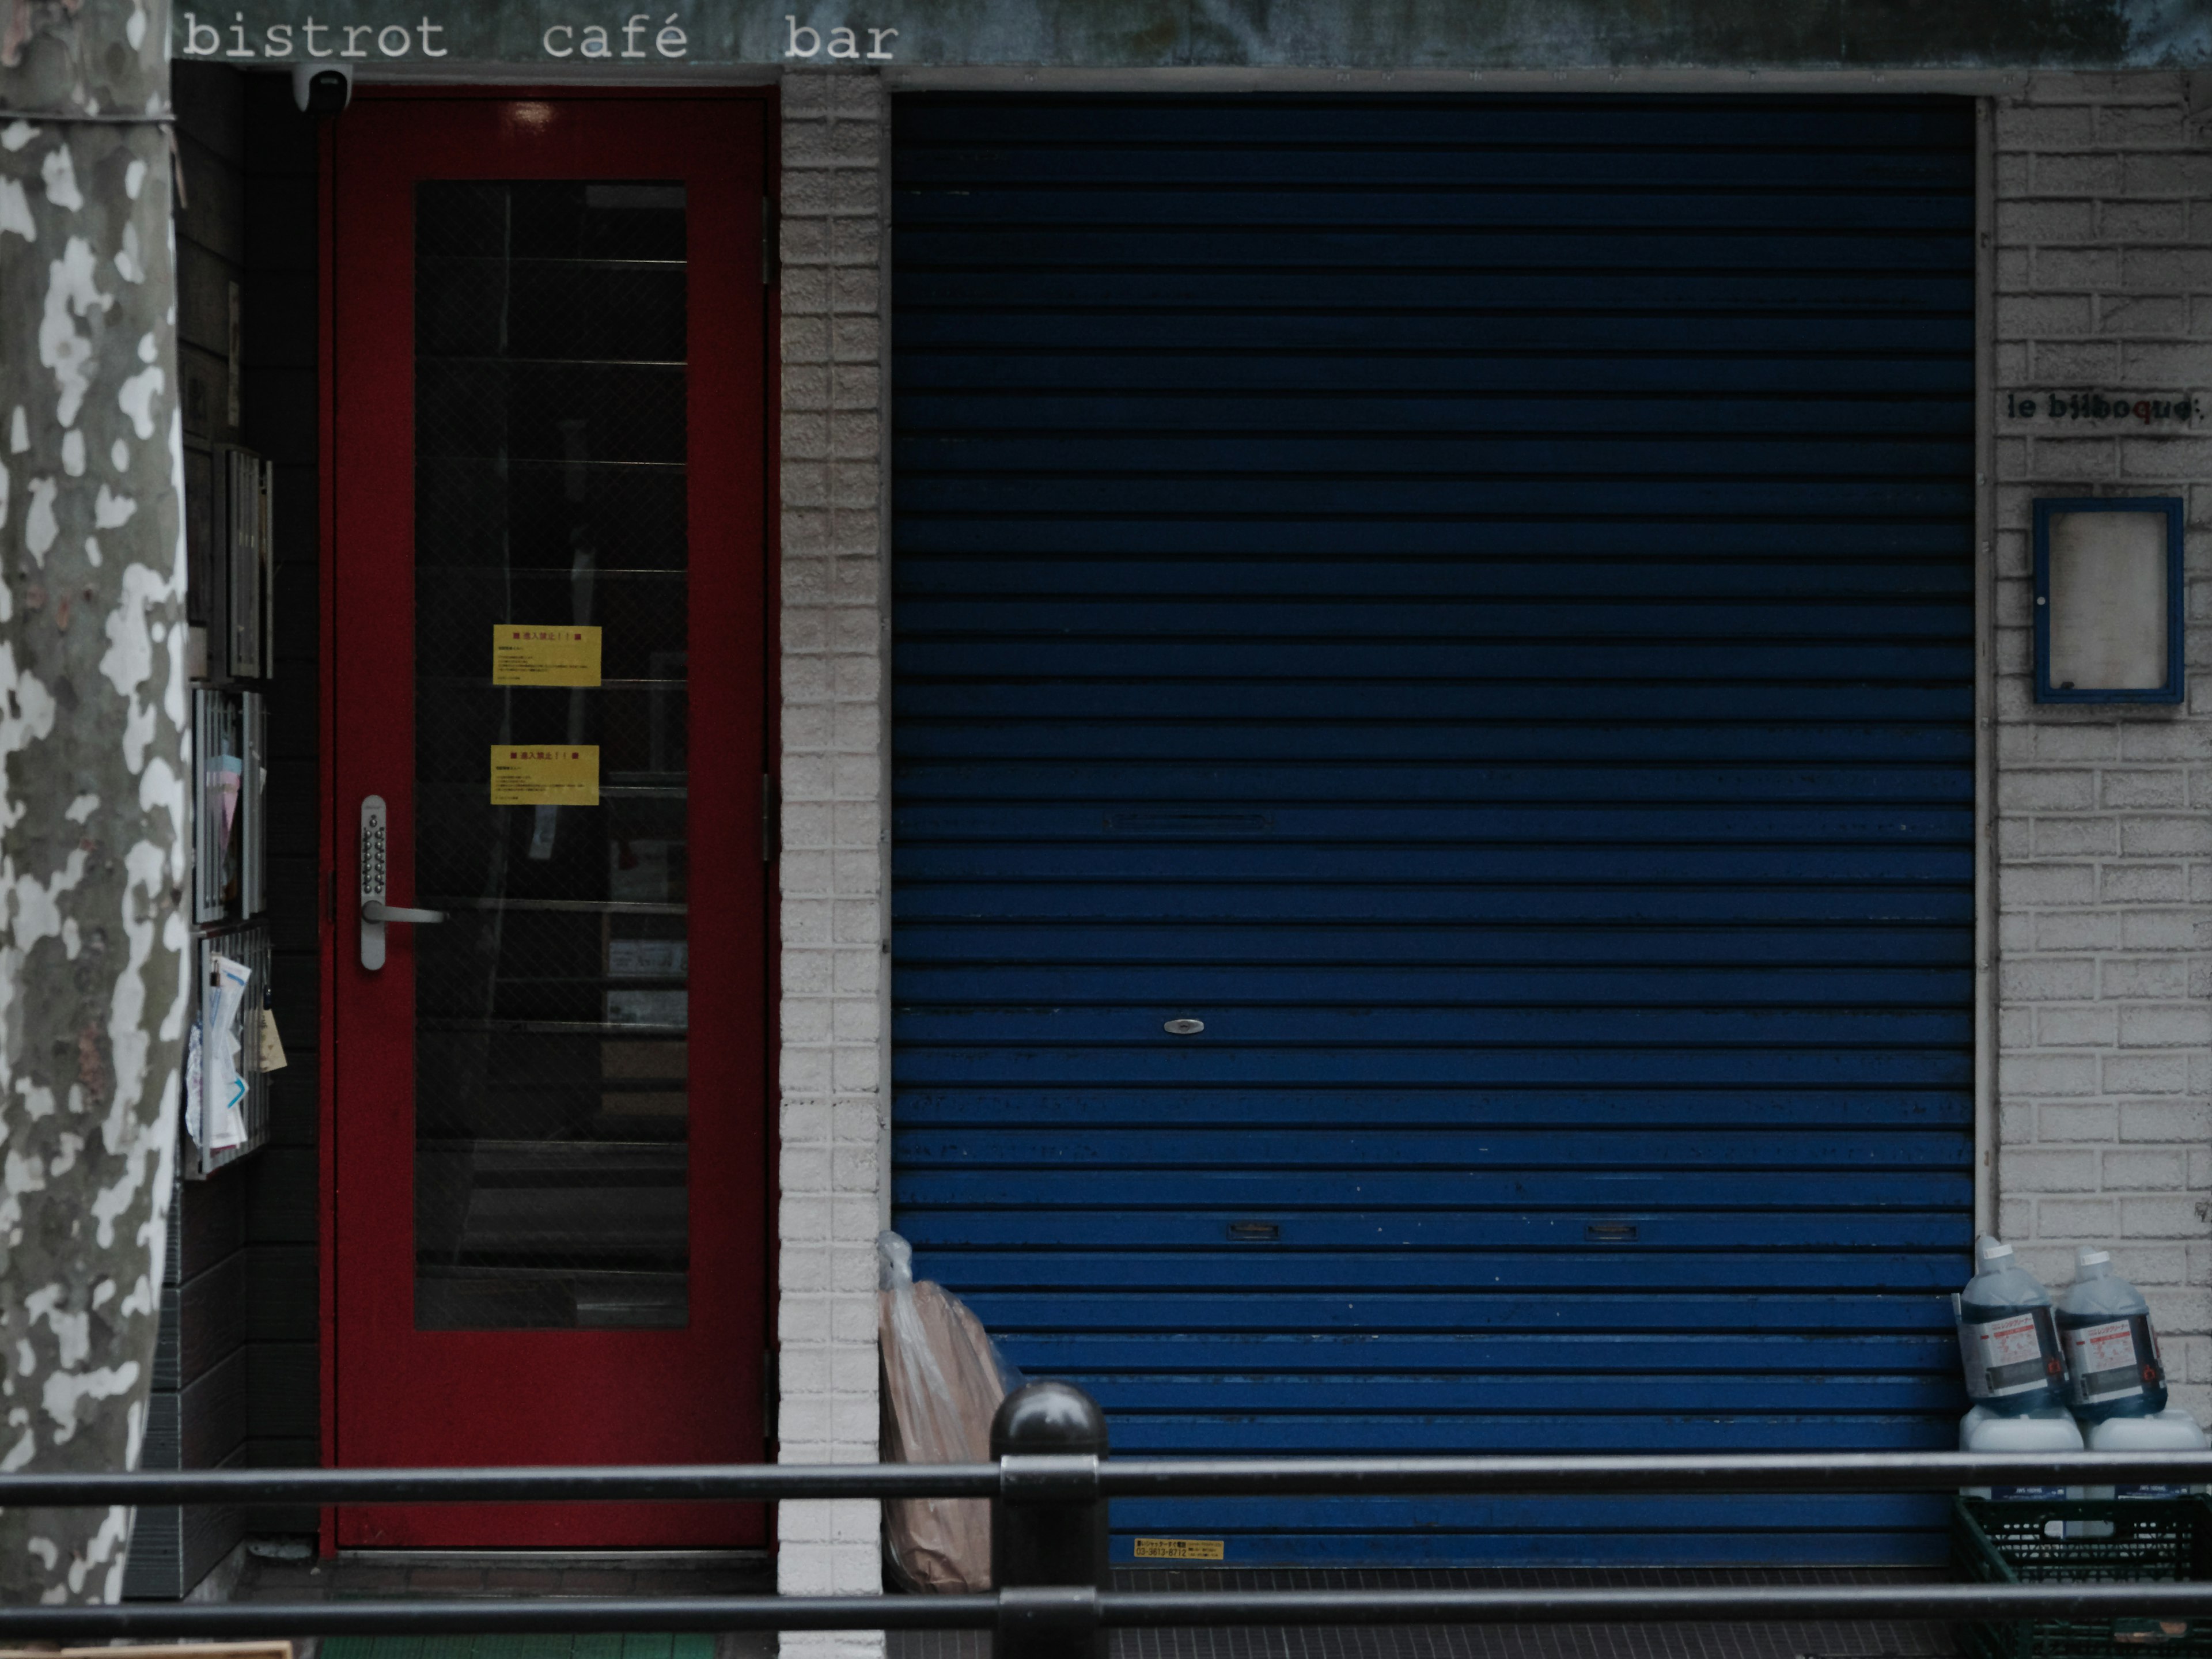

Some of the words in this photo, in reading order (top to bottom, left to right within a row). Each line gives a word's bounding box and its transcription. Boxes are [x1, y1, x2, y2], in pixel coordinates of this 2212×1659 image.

[183, 12, 448, 57] bistrot
[543, 13, 688, 58] café
[785, 15, 900, 59] bar
[2007, 393, 2036, 418] le
